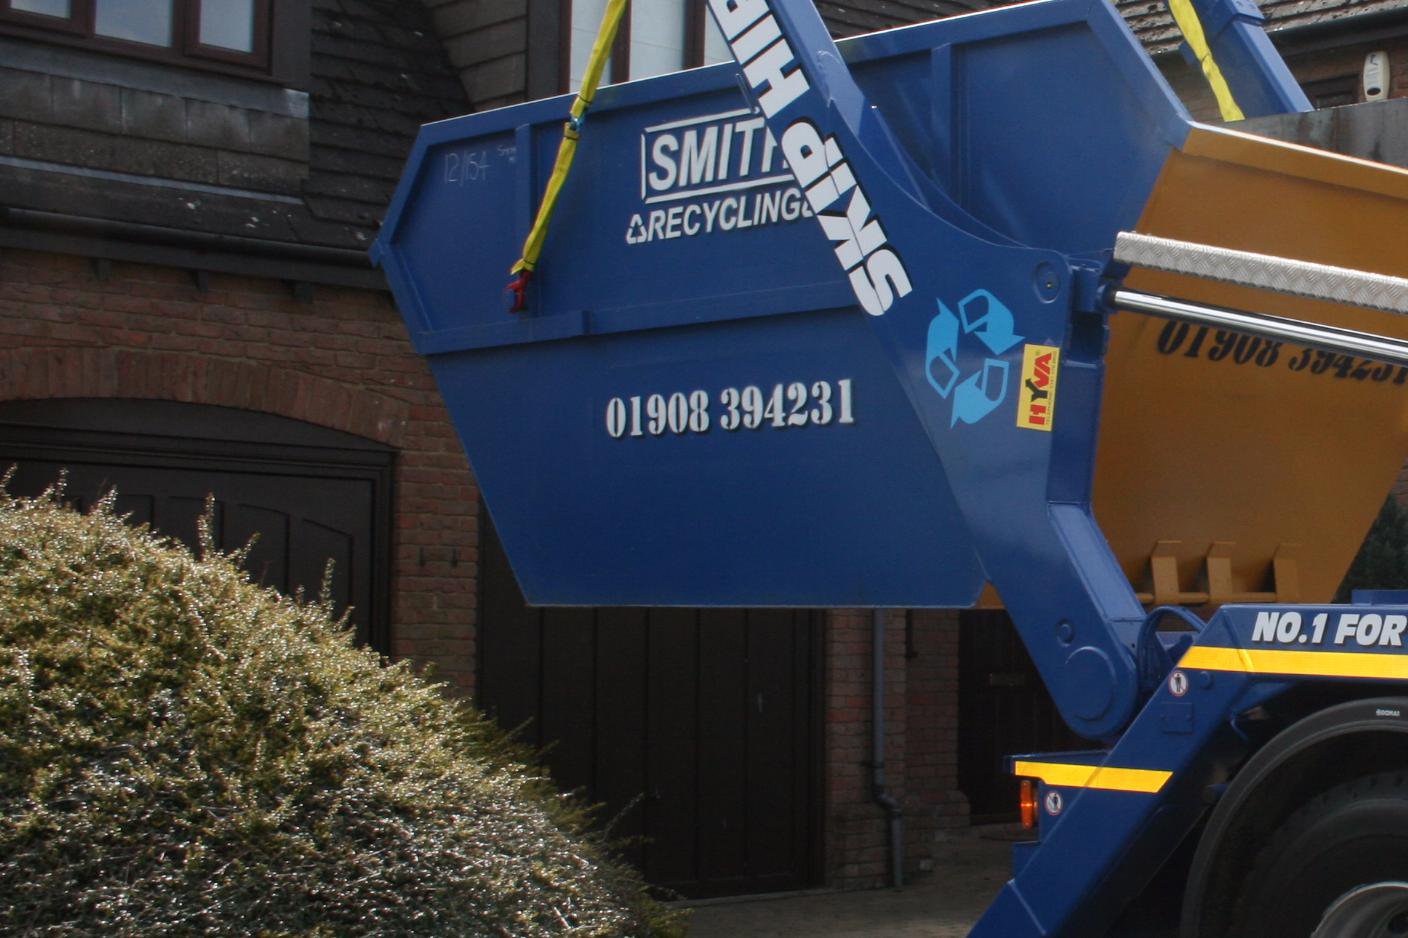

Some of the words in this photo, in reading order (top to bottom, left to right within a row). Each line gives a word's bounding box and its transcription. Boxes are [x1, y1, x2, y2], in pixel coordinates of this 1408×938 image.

[647, 187, 801, 242] RECYCLING
[781, 121, 912, 316] SKIP
[606, 389, 709, 438] 01908
[720, 379, 854, 430] 394231
[1025, 352, 1052, 425] HYVA
[1252, 611, 1327, 643] NO.1
[1334, 613, 1407, 646] FOR
